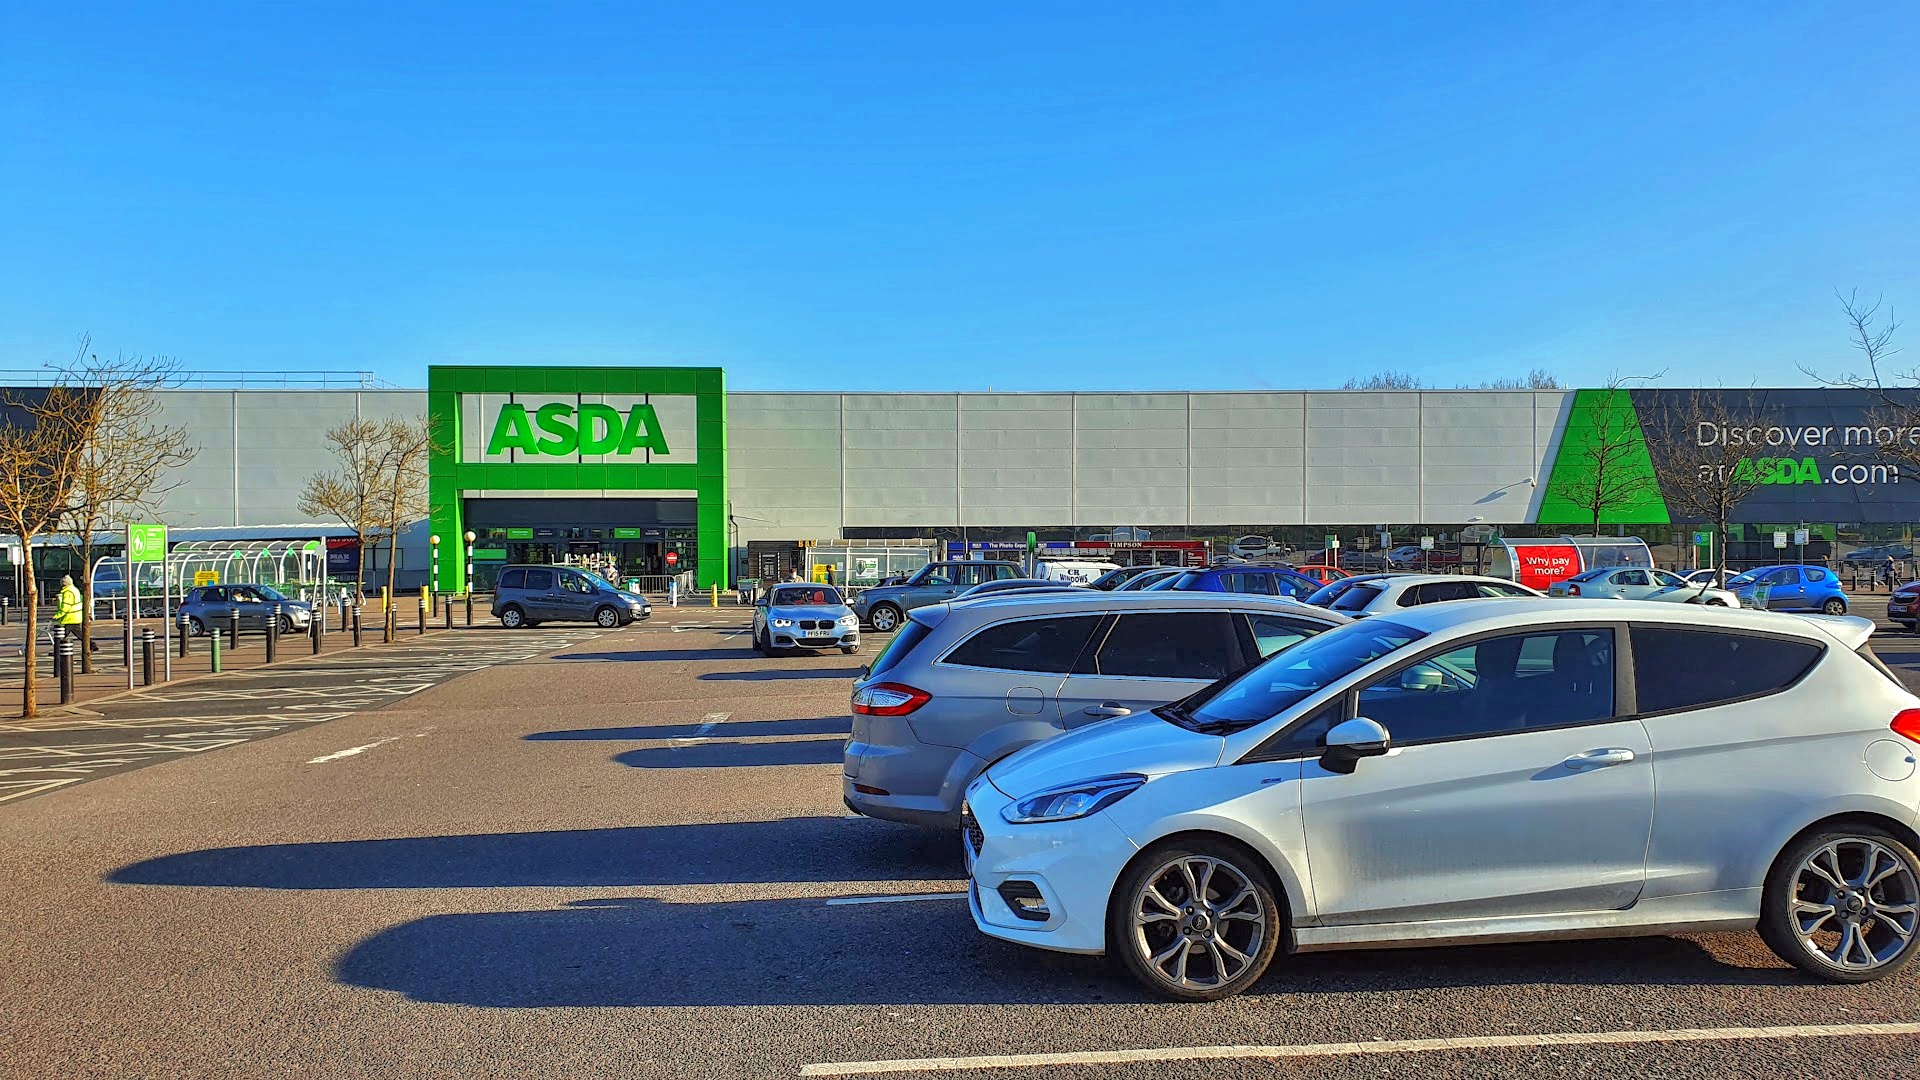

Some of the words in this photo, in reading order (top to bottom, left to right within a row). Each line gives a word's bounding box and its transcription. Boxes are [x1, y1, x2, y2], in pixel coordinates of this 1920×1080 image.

[486, 403, 670, 456] ASDA
[1697, 421, 1835, 446] Discover
[1845, 426, 1920, 446] more
[1698, 460, 1726, 484] at
[1526, 557, 1549, 566] Why
[1552, 557, 1570, 566] pay
[1059, 573, 1088, 583] WINDOWS
[1535, 567, 1565, 575] more?
